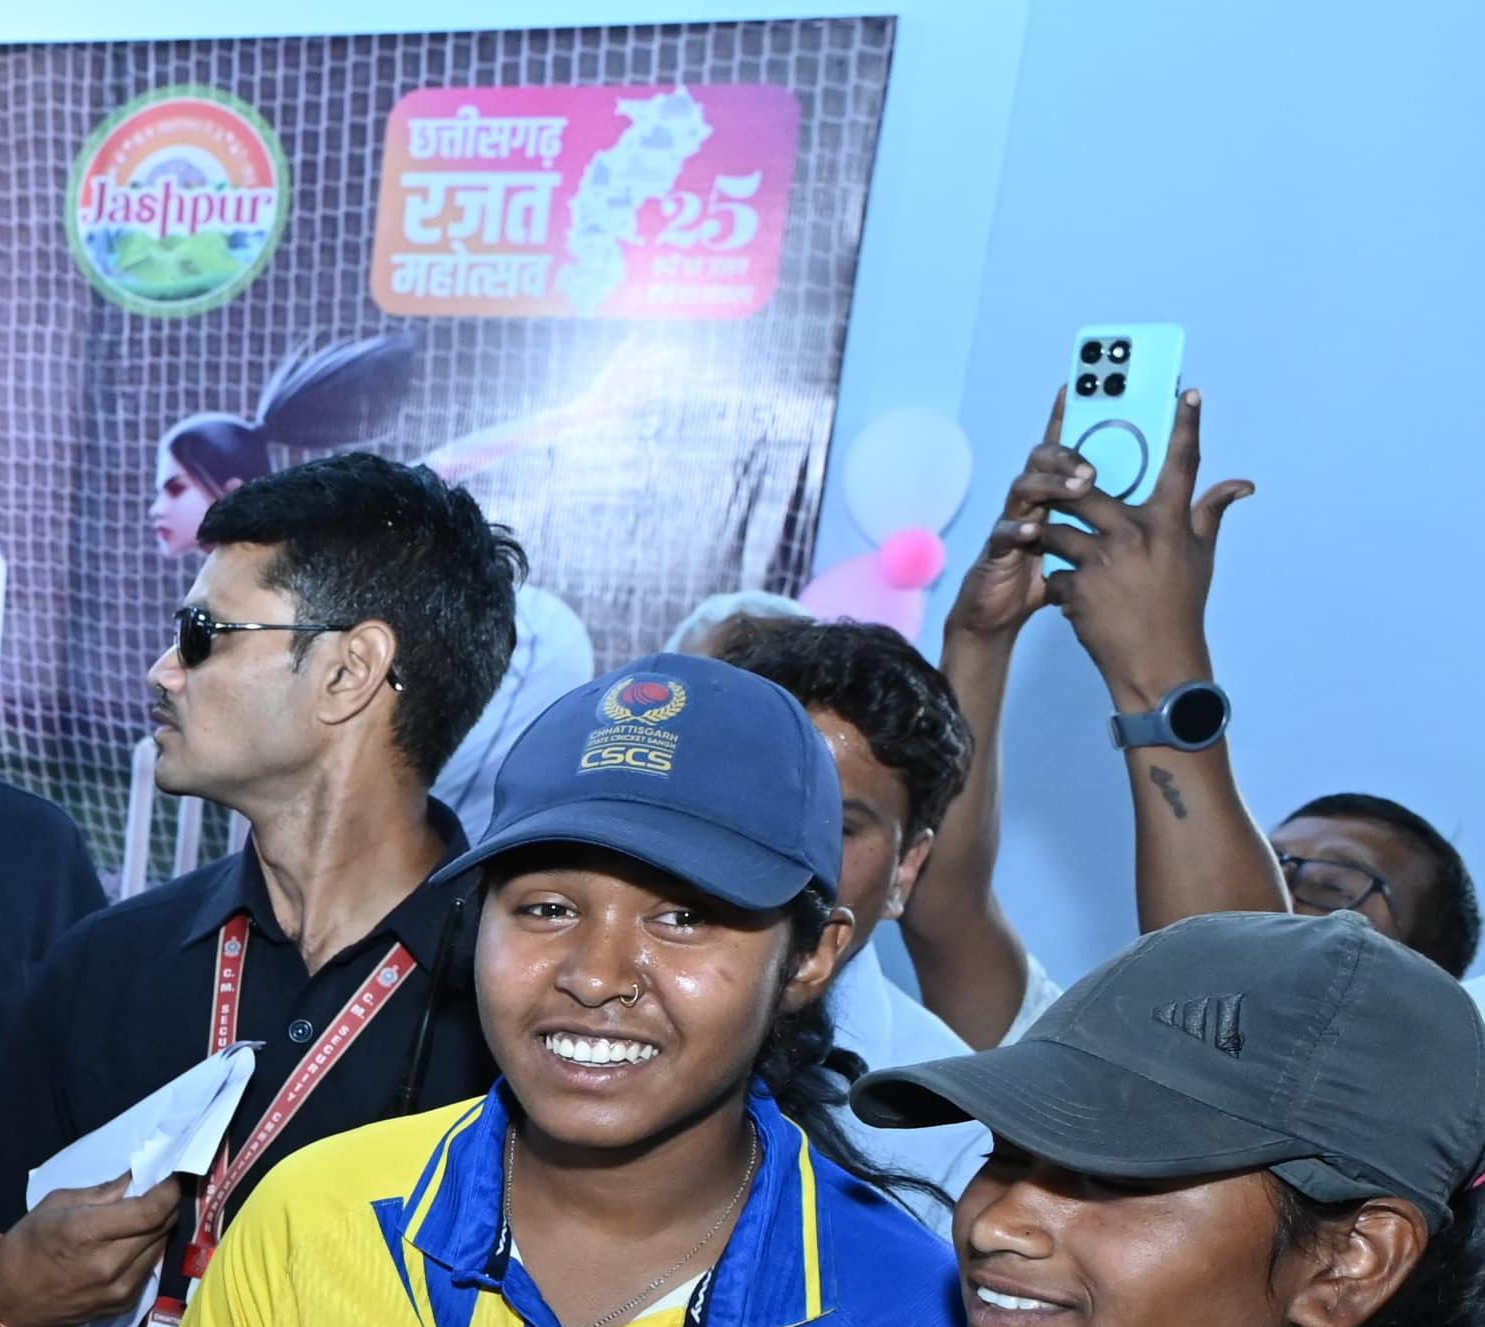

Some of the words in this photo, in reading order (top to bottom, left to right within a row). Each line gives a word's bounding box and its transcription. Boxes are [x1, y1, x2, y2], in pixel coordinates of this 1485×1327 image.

[407, 104, 569, 168] छत्तीसगढ़
[81, 180, 273, 240] Jashpur
[400, 171, 562, 245] रजत
[657, 169, 763, 250] 25
[390, 239, 552, 299] महोत्सव
[581, 746, 672, 771] CSCS
[589, 725, 678, 742] CHHATTISGARH
